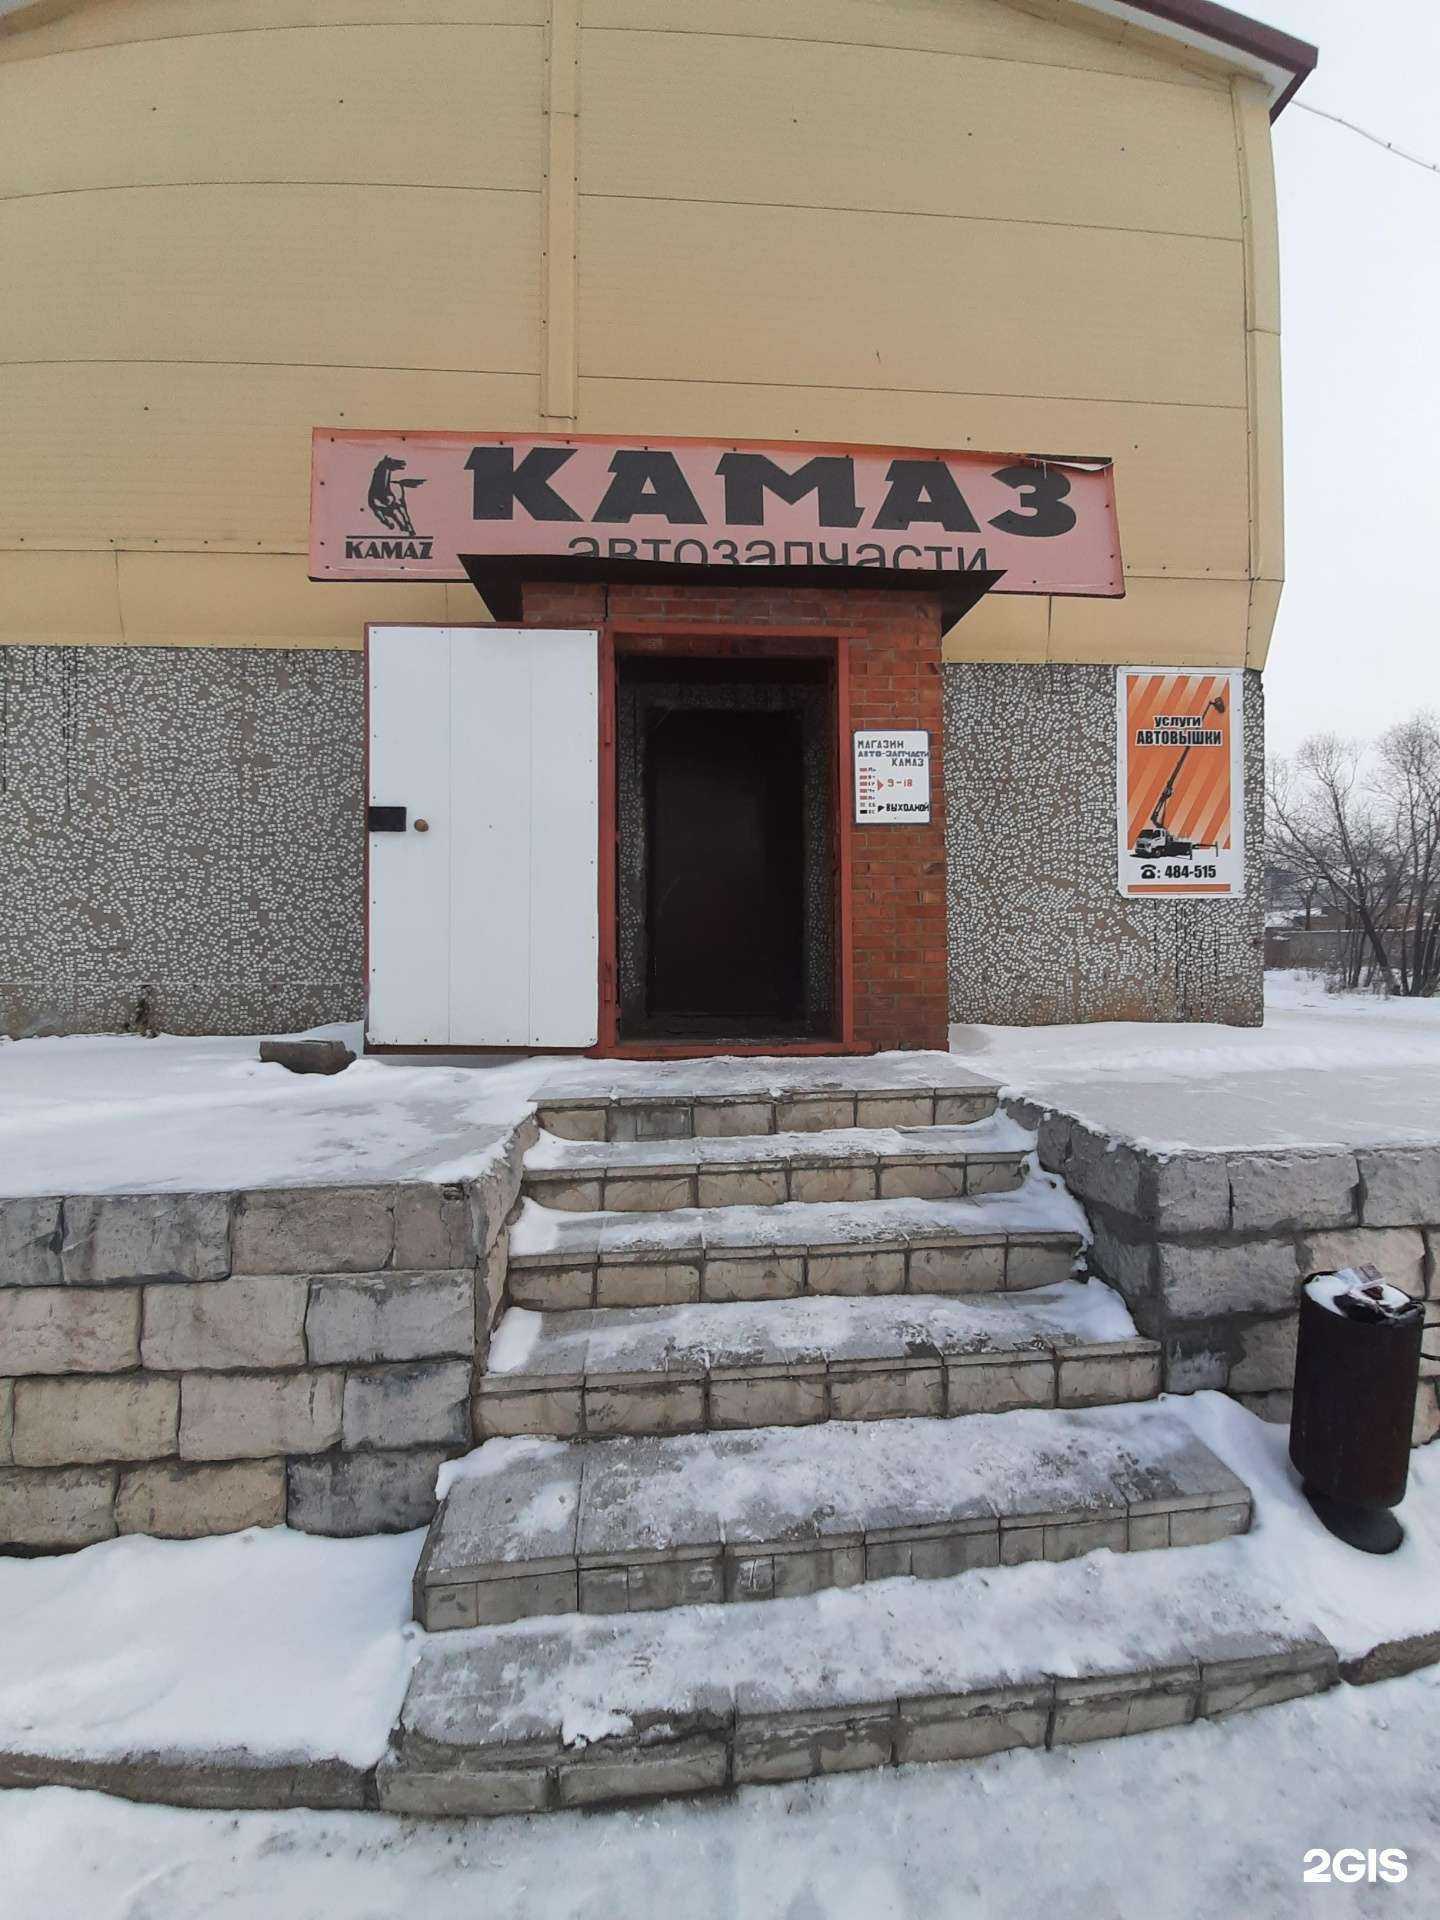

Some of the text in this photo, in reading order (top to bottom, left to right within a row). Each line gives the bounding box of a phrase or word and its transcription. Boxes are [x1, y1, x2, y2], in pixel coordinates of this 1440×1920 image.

[463, 447, 1076, 537] КАМАЗ
[345, 540, 434, 560] KAMAZ
[857, 740, 904, 749] МАГАЗИН
[1136, 730, 1222, 745] АВТОВЫШКИ
[891, 758, 924, 767] КАМАЗ
[1165, 865, 1216, 879] 484-515
